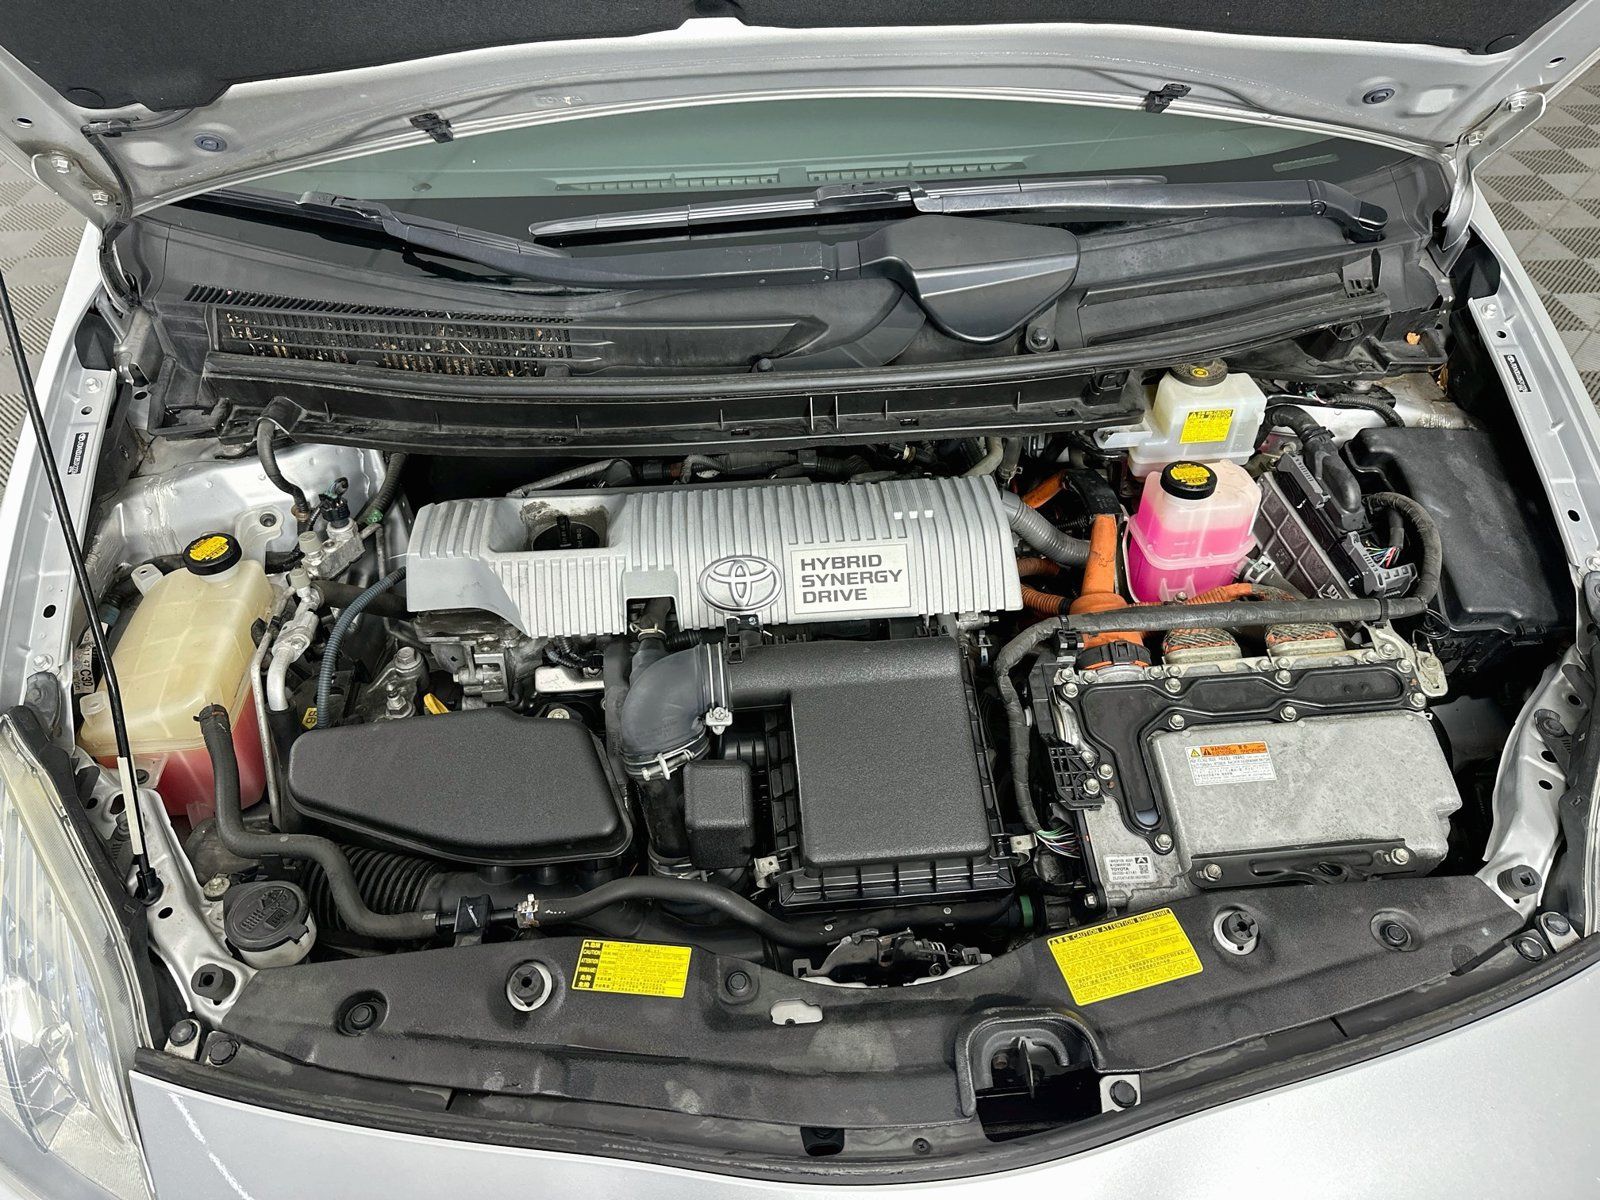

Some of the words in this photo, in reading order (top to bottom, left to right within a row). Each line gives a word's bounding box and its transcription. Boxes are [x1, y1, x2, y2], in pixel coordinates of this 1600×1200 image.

[800, 554, 882, 571] HYBRID
[801, 569, 903, 588] SYNERGY
[802, 588, 868, 604] DRIVE
